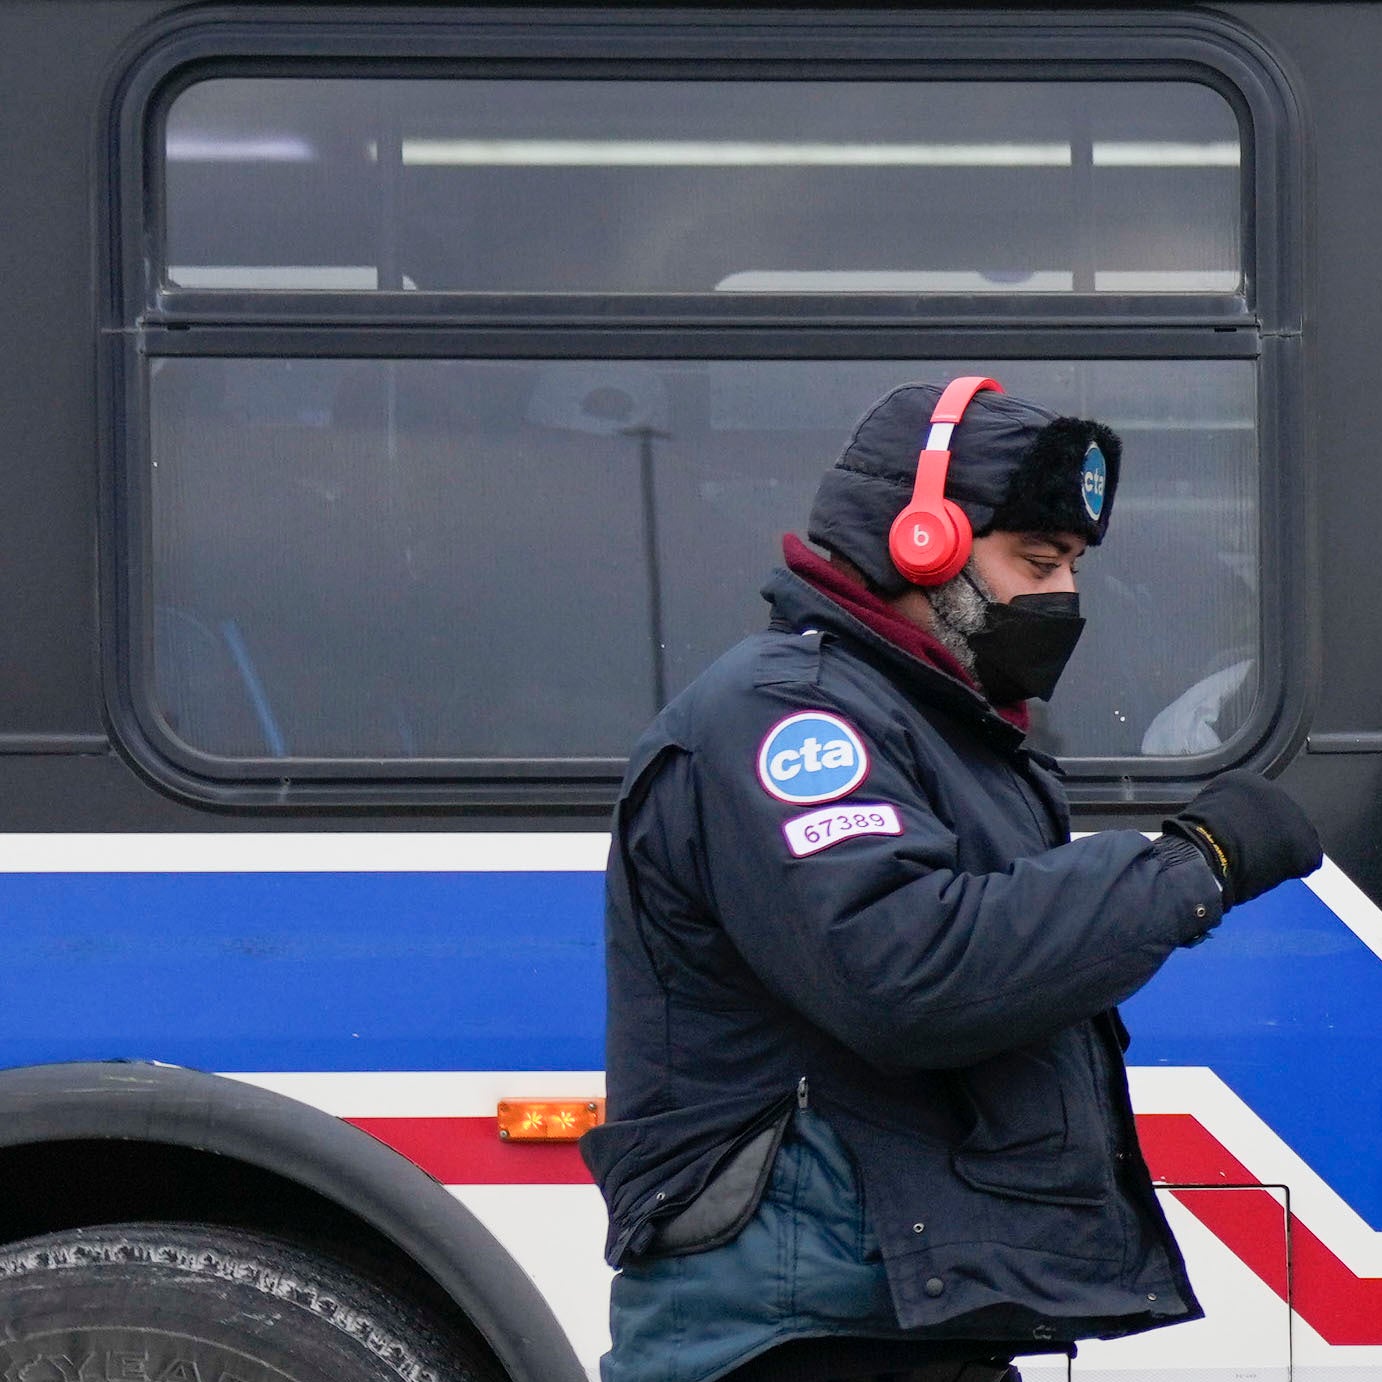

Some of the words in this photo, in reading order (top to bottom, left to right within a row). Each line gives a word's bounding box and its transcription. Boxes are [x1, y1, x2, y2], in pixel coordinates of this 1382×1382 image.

[1084, 468, 1105, 497] cta
[769, 737, 855, 782] cta
[803, 813, 885, 844] 67389
